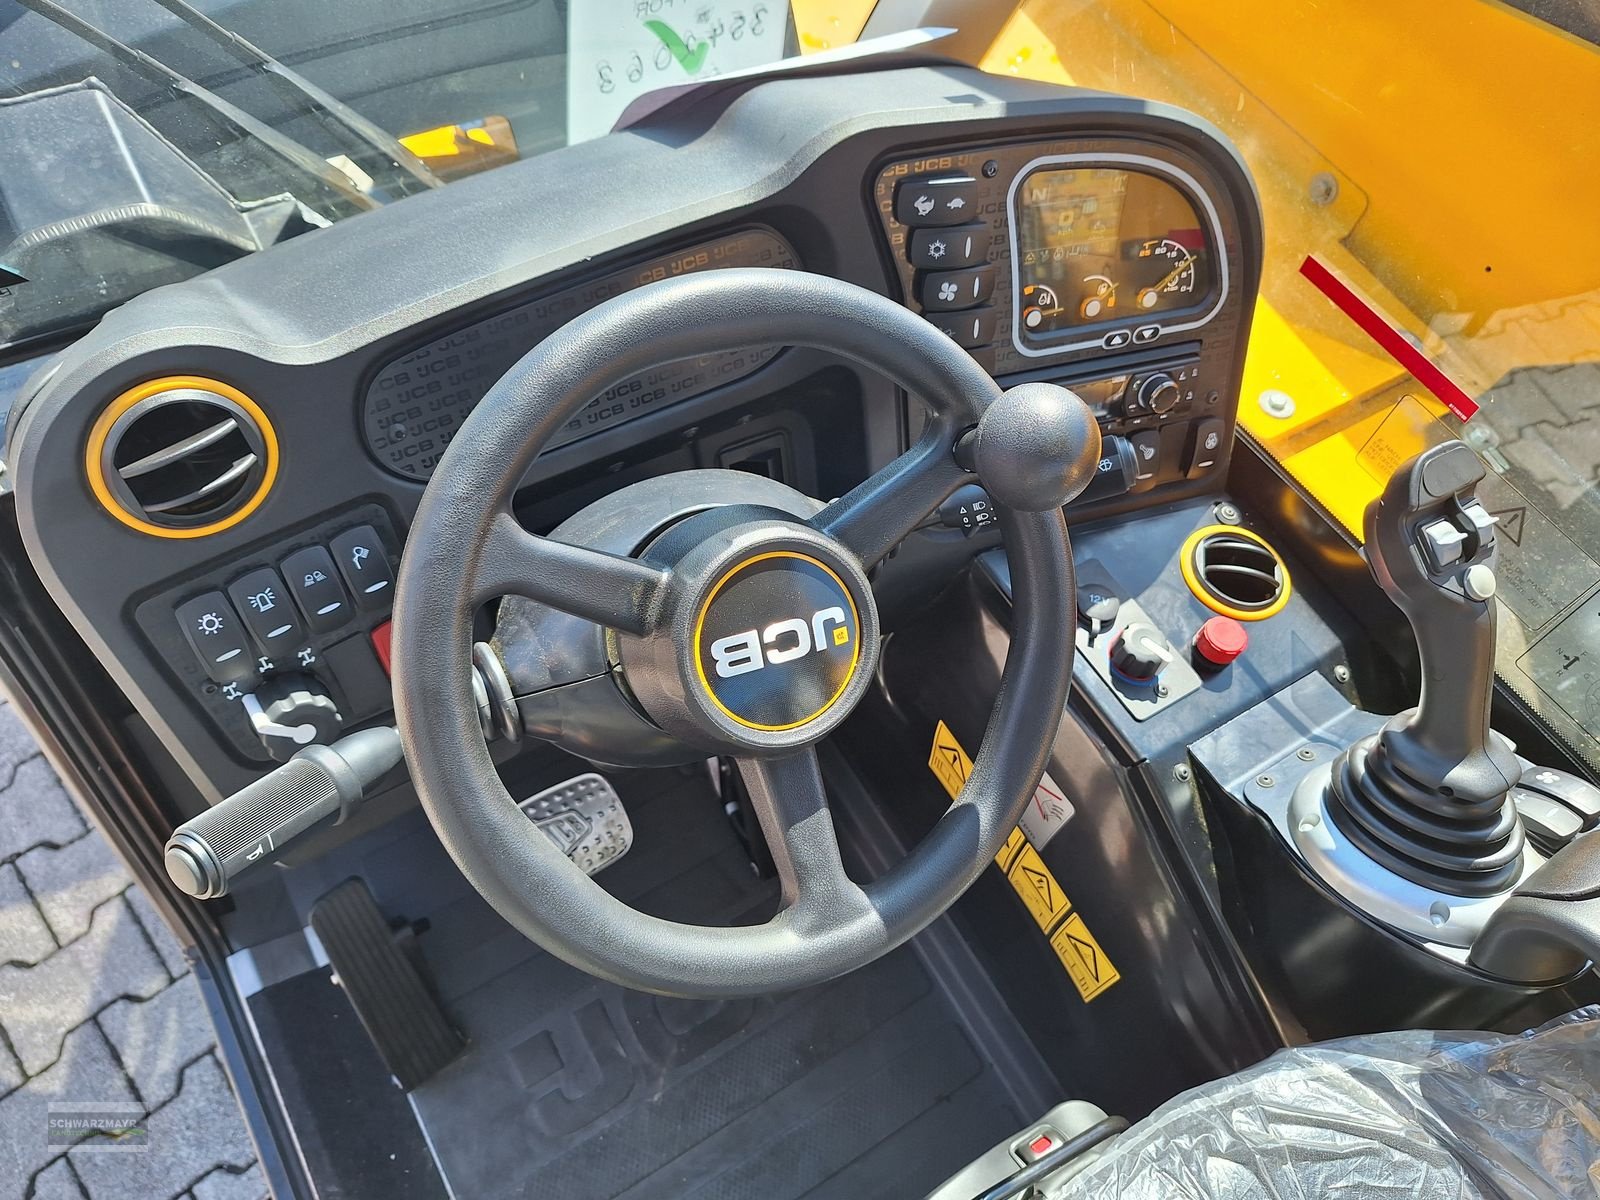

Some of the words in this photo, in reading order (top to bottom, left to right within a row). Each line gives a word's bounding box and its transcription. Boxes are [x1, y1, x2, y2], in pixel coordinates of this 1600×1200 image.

[914, 157, 952, 173] JCB
[671, 252, 709, 275] JCB
[379, 371, 412, 392] CB
[416, 354, 462, 379] JCB
[397, 380, 443, 404] JCB
[604, 379, 643, 401] JCB
[376, 406, 423, 430] JCB
[428, 388, 472, 412] JCB
[586, 402, 625, 425] JCB
[630, 387, 667, 409] JCB
[409, 413, 454, 437] JCB
[389, 439, 435, 463] JCB
[711, 606, 849, 679] JCB
